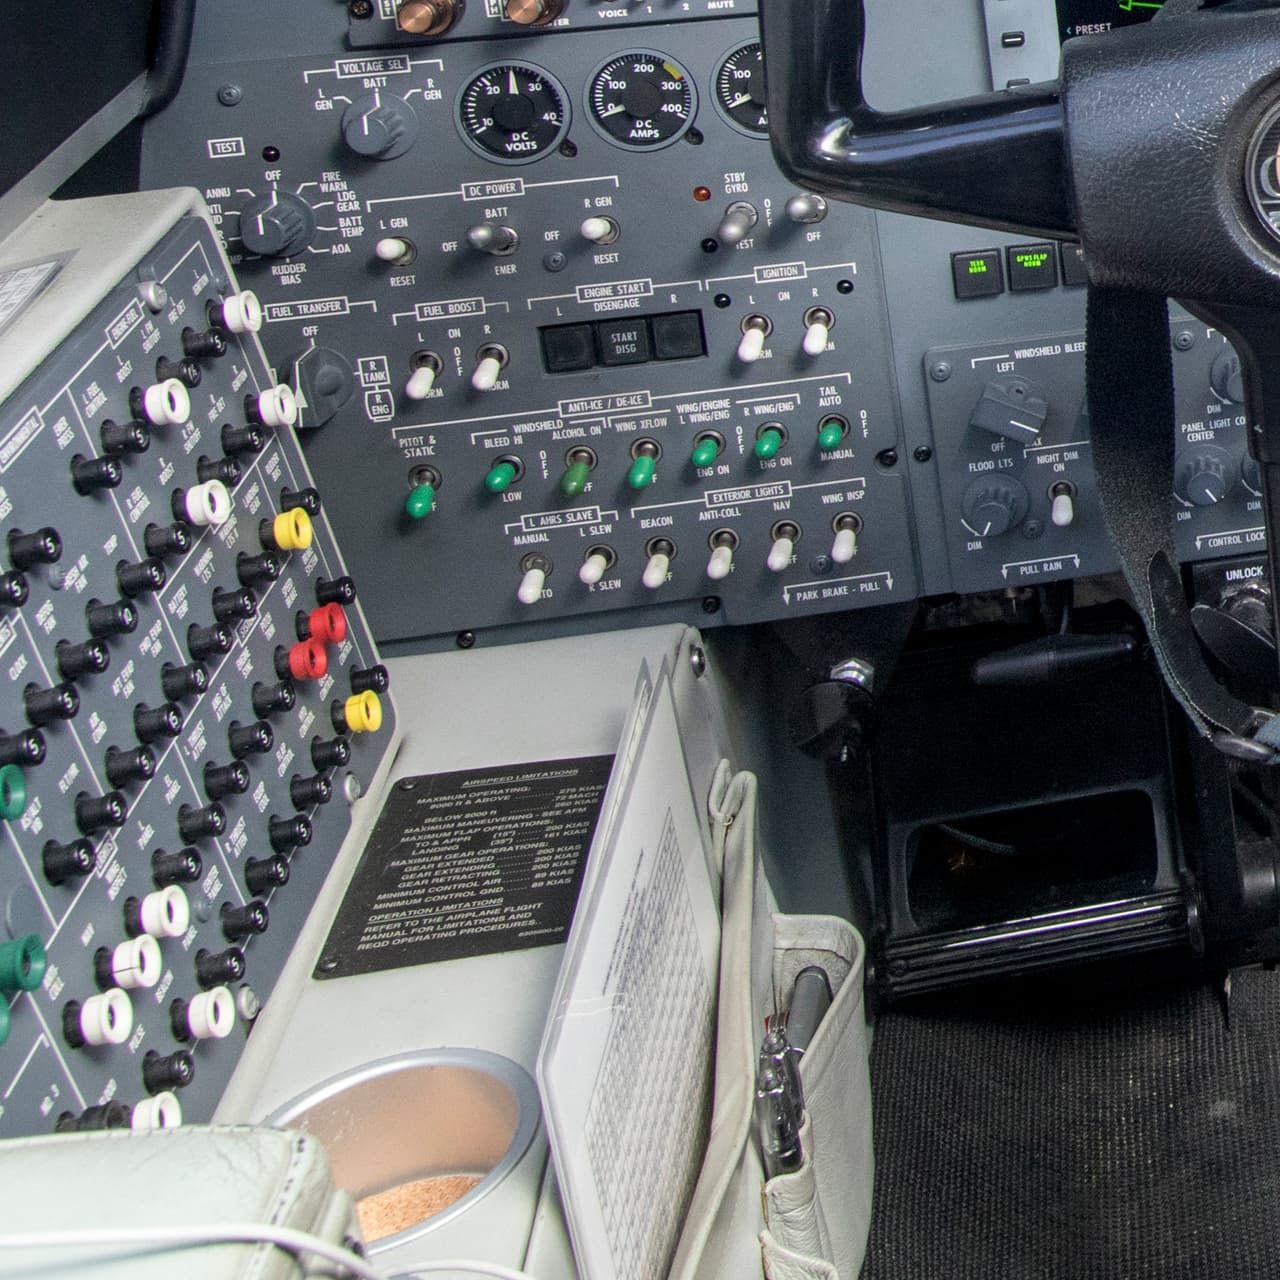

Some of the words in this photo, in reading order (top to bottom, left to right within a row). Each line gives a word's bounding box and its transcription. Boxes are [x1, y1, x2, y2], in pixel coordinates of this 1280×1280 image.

[707, 0, 734, 9] MUTE
[1075, 23, 1112, 35] PRESET
[343, 62, 384, 73] VOLTAGE
[387, 60, 404, 70] SEL
[661, 103, 682, 112] 400
[630, 128, 659, 138] AMPS
[215, 142, 237, 154] TEST
[506, 140, 537, 152] VOLTS
[322, 171, 341, 182] FIRE
[724, 173, 745, 183] STBY
[320, 181, 347, 192] WARN
[470, 186, 484, 196] DC
[487, 182, 516, 195] POWER
[725, 183, 748, 193] GYRO
[763, 266, 798, 278] IGNITION
[584, 286, 616, 298] ENGINE
[618, 282, 644, 295] START
[272, 305, 291, 317] FUEL
[295, 301, 341, 314] TRANSFER
[676, 399, 731, 413] WING/ENGINE
[820, 449, 854, 461] MANUAL
[969, 460, 994, 472] FLOOD
[998, 458, 1013, 468] LTS
[713, 489, 752, 503] EXTERIOR
[755, 485, 784, 498] LIGHTS
[641, 516, 673, 528] BEACON
[1020, 563, 1040, 574] PULL
[1043, 561, 1062, 572] RAIN
[1226, 566, 1263, 581] UNLOCK
